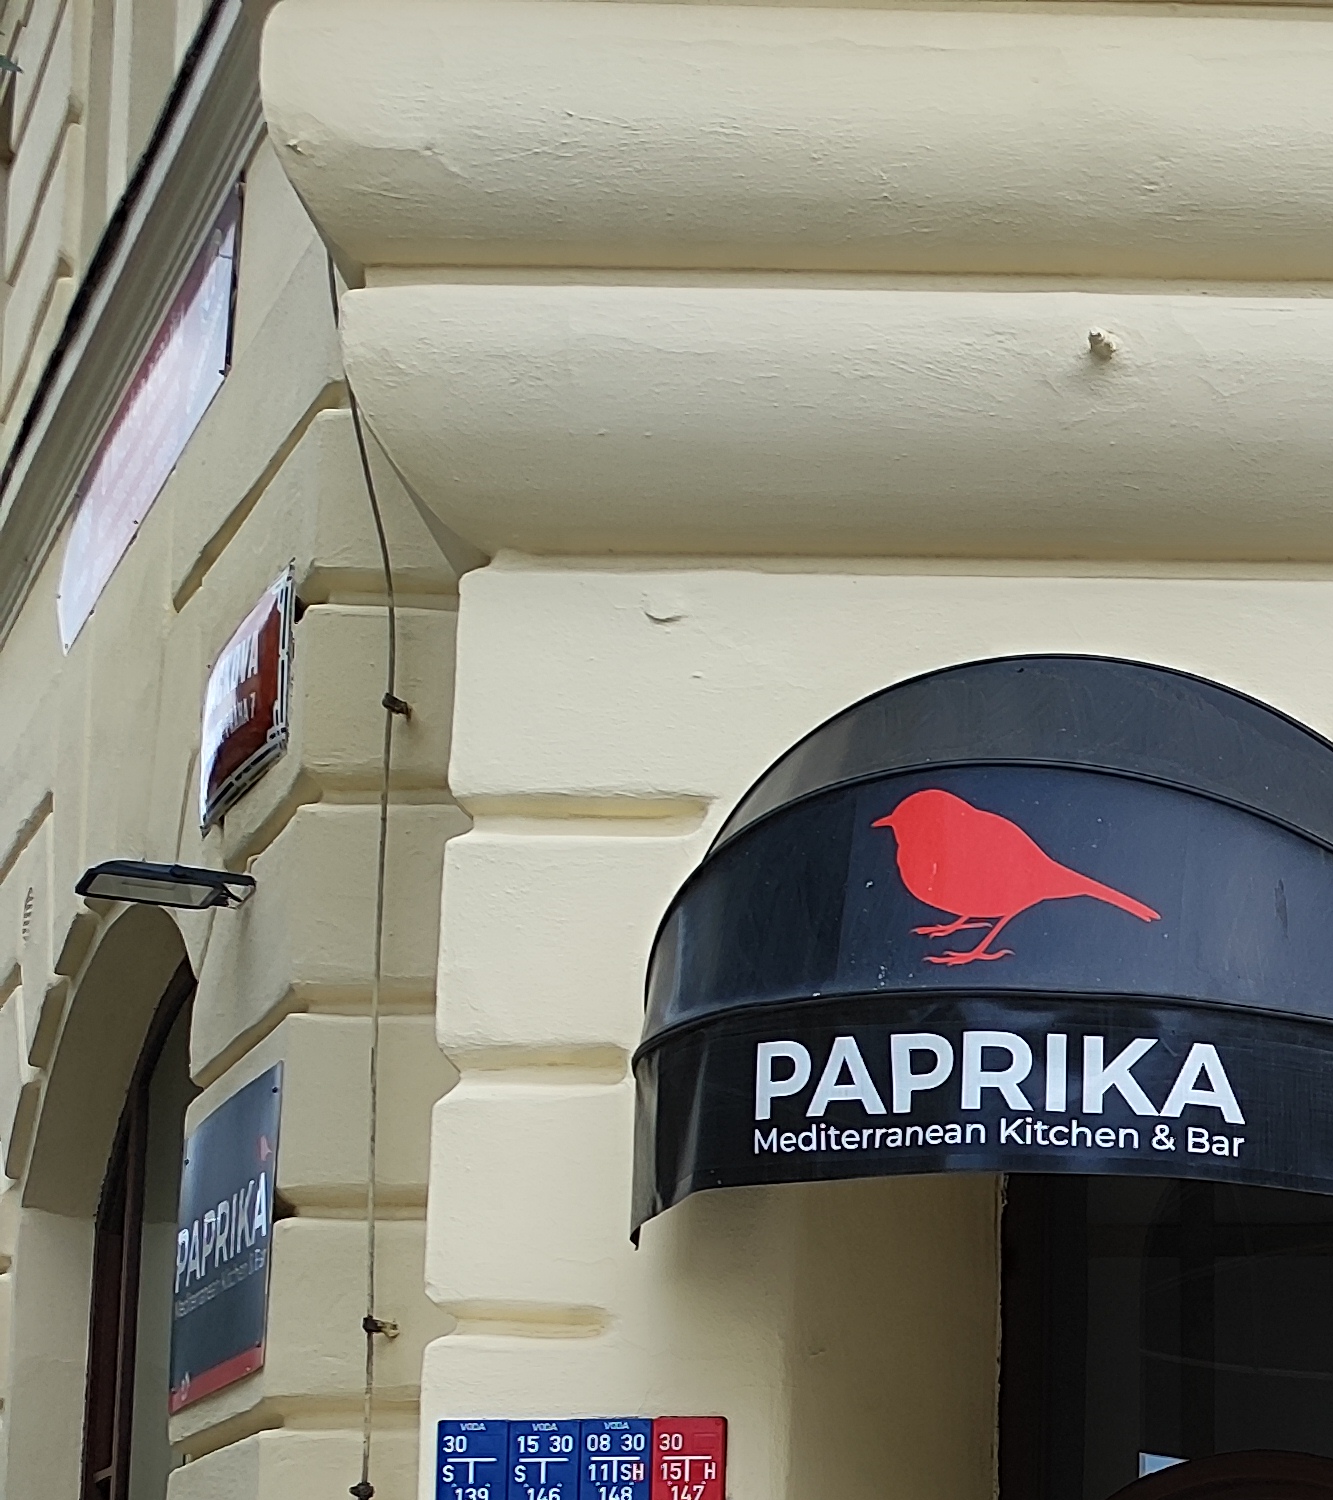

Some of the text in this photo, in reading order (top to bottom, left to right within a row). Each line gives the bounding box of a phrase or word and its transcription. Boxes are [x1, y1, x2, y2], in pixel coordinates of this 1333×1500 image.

[754, 1030, 1246, 1124] PAPRIKA
[753, 1116, 1245, 1157] Mediterranean Kitchen & Bar
[175, 1171, 267, 1294] PAPRIKA
[460, 1423, 487, 1432] VODA
[532, 1423, 559, 1432] VODA
[604, 1421, 631, 1430] VODA
[442, 1435, 468, 1453] 30
[517, 1435, 574, 1453] 15 30
[586, 1434, 645, 1451] 08 30
[659, 1433, 683, 1451] 30
[442, 1465, 455, 1483] S
[514, 1465, 527, 1483] S
[588, 1463, 645, 1482] 11 SH
[661, 1461, 716, 1480] 15 H
